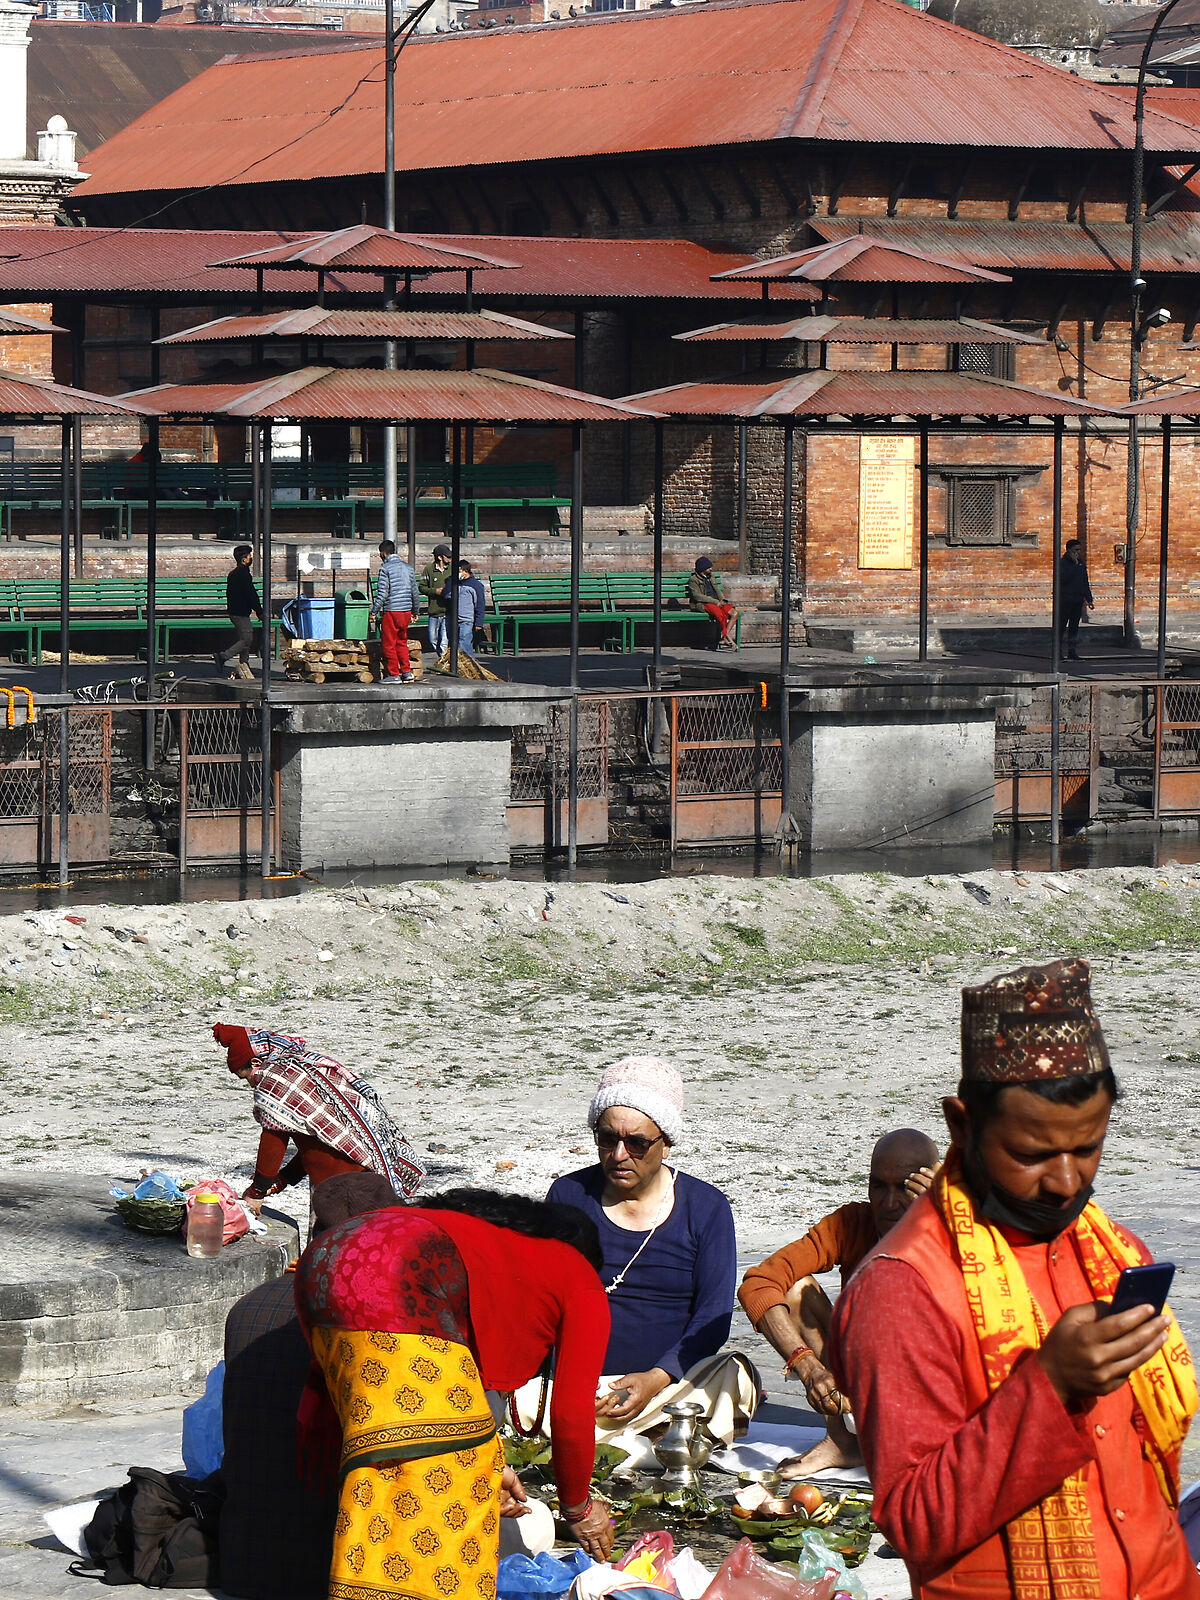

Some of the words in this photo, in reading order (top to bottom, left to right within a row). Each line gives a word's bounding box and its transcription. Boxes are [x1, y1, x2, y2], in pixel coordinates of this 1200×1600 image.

[953, 1200, 975, 1238] जय
[961, 1249, 986, 1277] श्री
[998, 1274, 1012, 1297] राम
